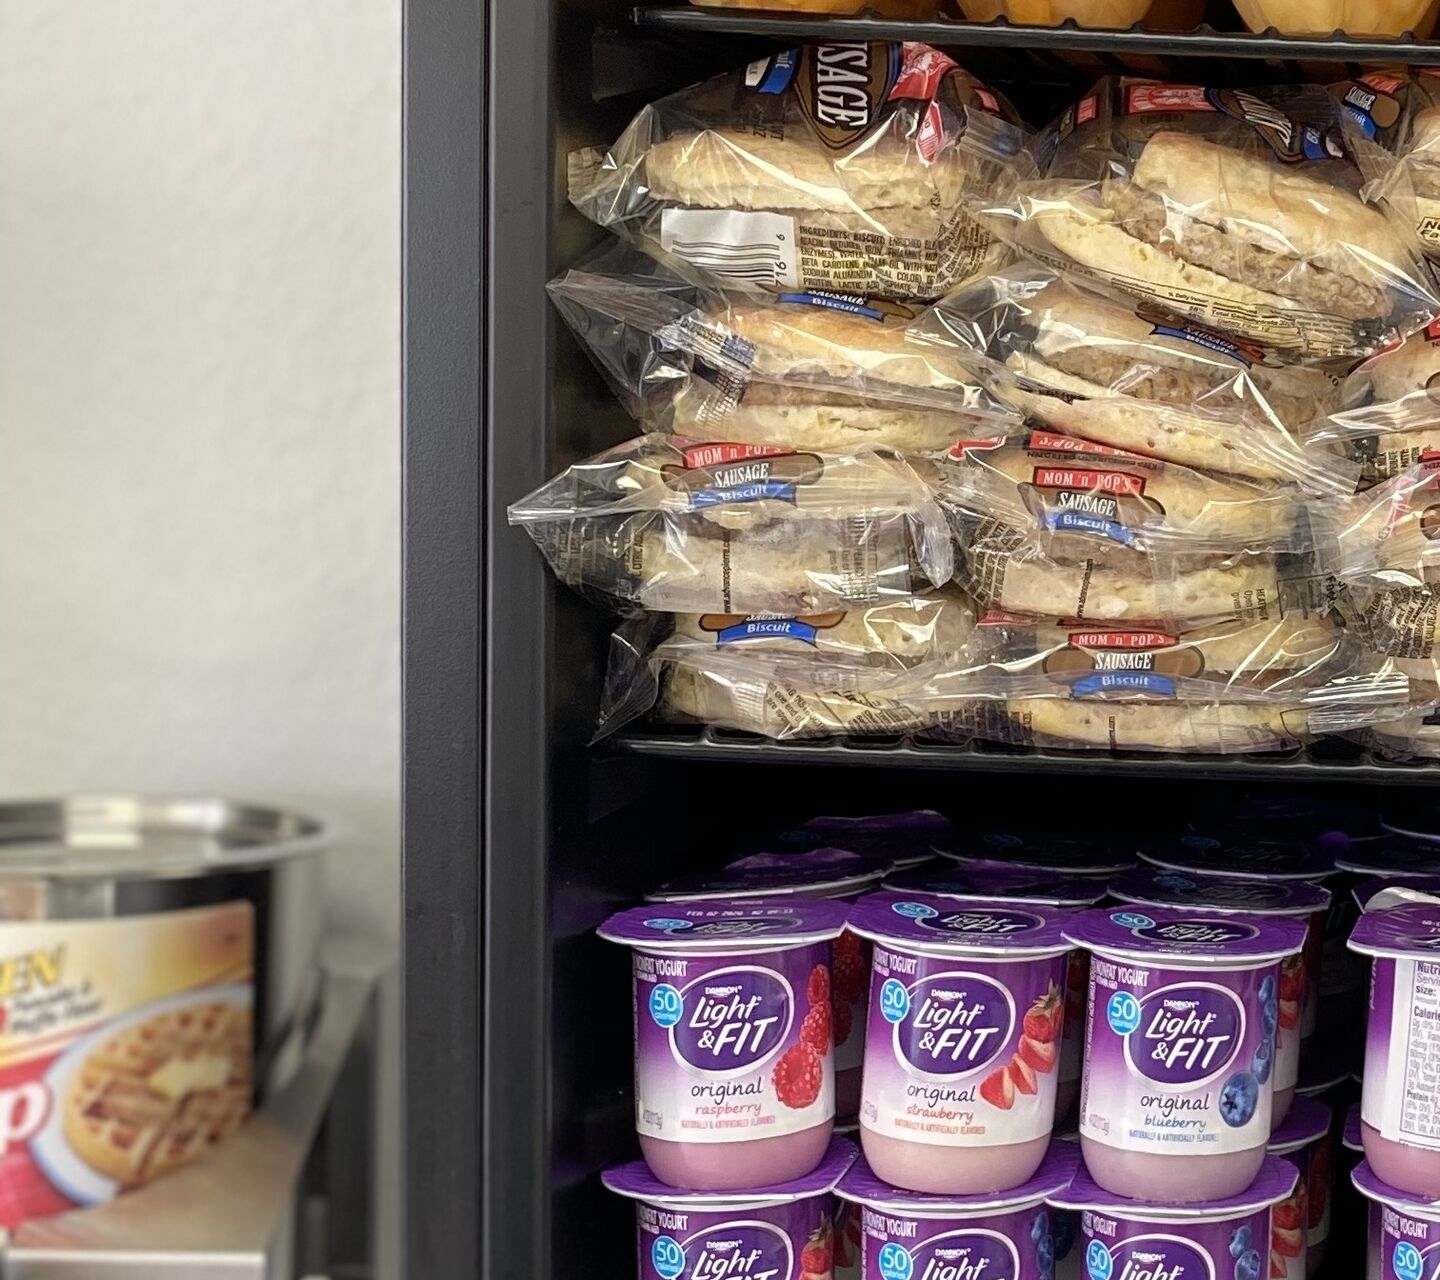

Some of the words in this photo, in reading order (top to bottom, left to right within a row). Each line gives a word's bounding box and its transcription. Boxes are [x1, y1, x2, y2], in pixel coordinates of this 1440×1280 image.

[817, 41, 869, 127] SAGE
[693, 449, 723, 466] MOM
[715, 462, 770, 488] SAUSAGE
[1043, 471, 1076, 486] MOM
[720, 483, 768, 500] Biscuit
[1058, 491, 1116, 517] SAUSAGE
[1063, 514, 1112, 532] Biscuit
[747, 620, 792, 634] Biscuit
[1078, 634, 1110, 646] MOM
[1130, 633, 1165, 646] POP'S
[1094, 652, 1153, 670] SAUSAGE
[1102, 674, 1151, 688] Biscuit
[883, 986, 906, 1009] 50
[1416, 984, 1436, 996] size:
[654, 992, 678, 1013] 50
[690, 996, 762, 1029] Light
[1111, 996, 1136, 1020] 50
[913, 1003, 983, 1035] Light
[1145, 1010, 1214, 1041] Light
[690, 1077, 763, 1105] original
[906, 1084, 977, 1114] original
[906, 1106, 974, 1121] strawberry
[1140, 1094, 1211, 1123] original
[1144, 1115, 1208, 1131] blueberry
[655, 1244, 680, 1264] 50
[883, 1252, 907, 1271] 50
[1090, 1249, 1109, 1270] 50
[1395, 1250, 1419, 1272] 50
